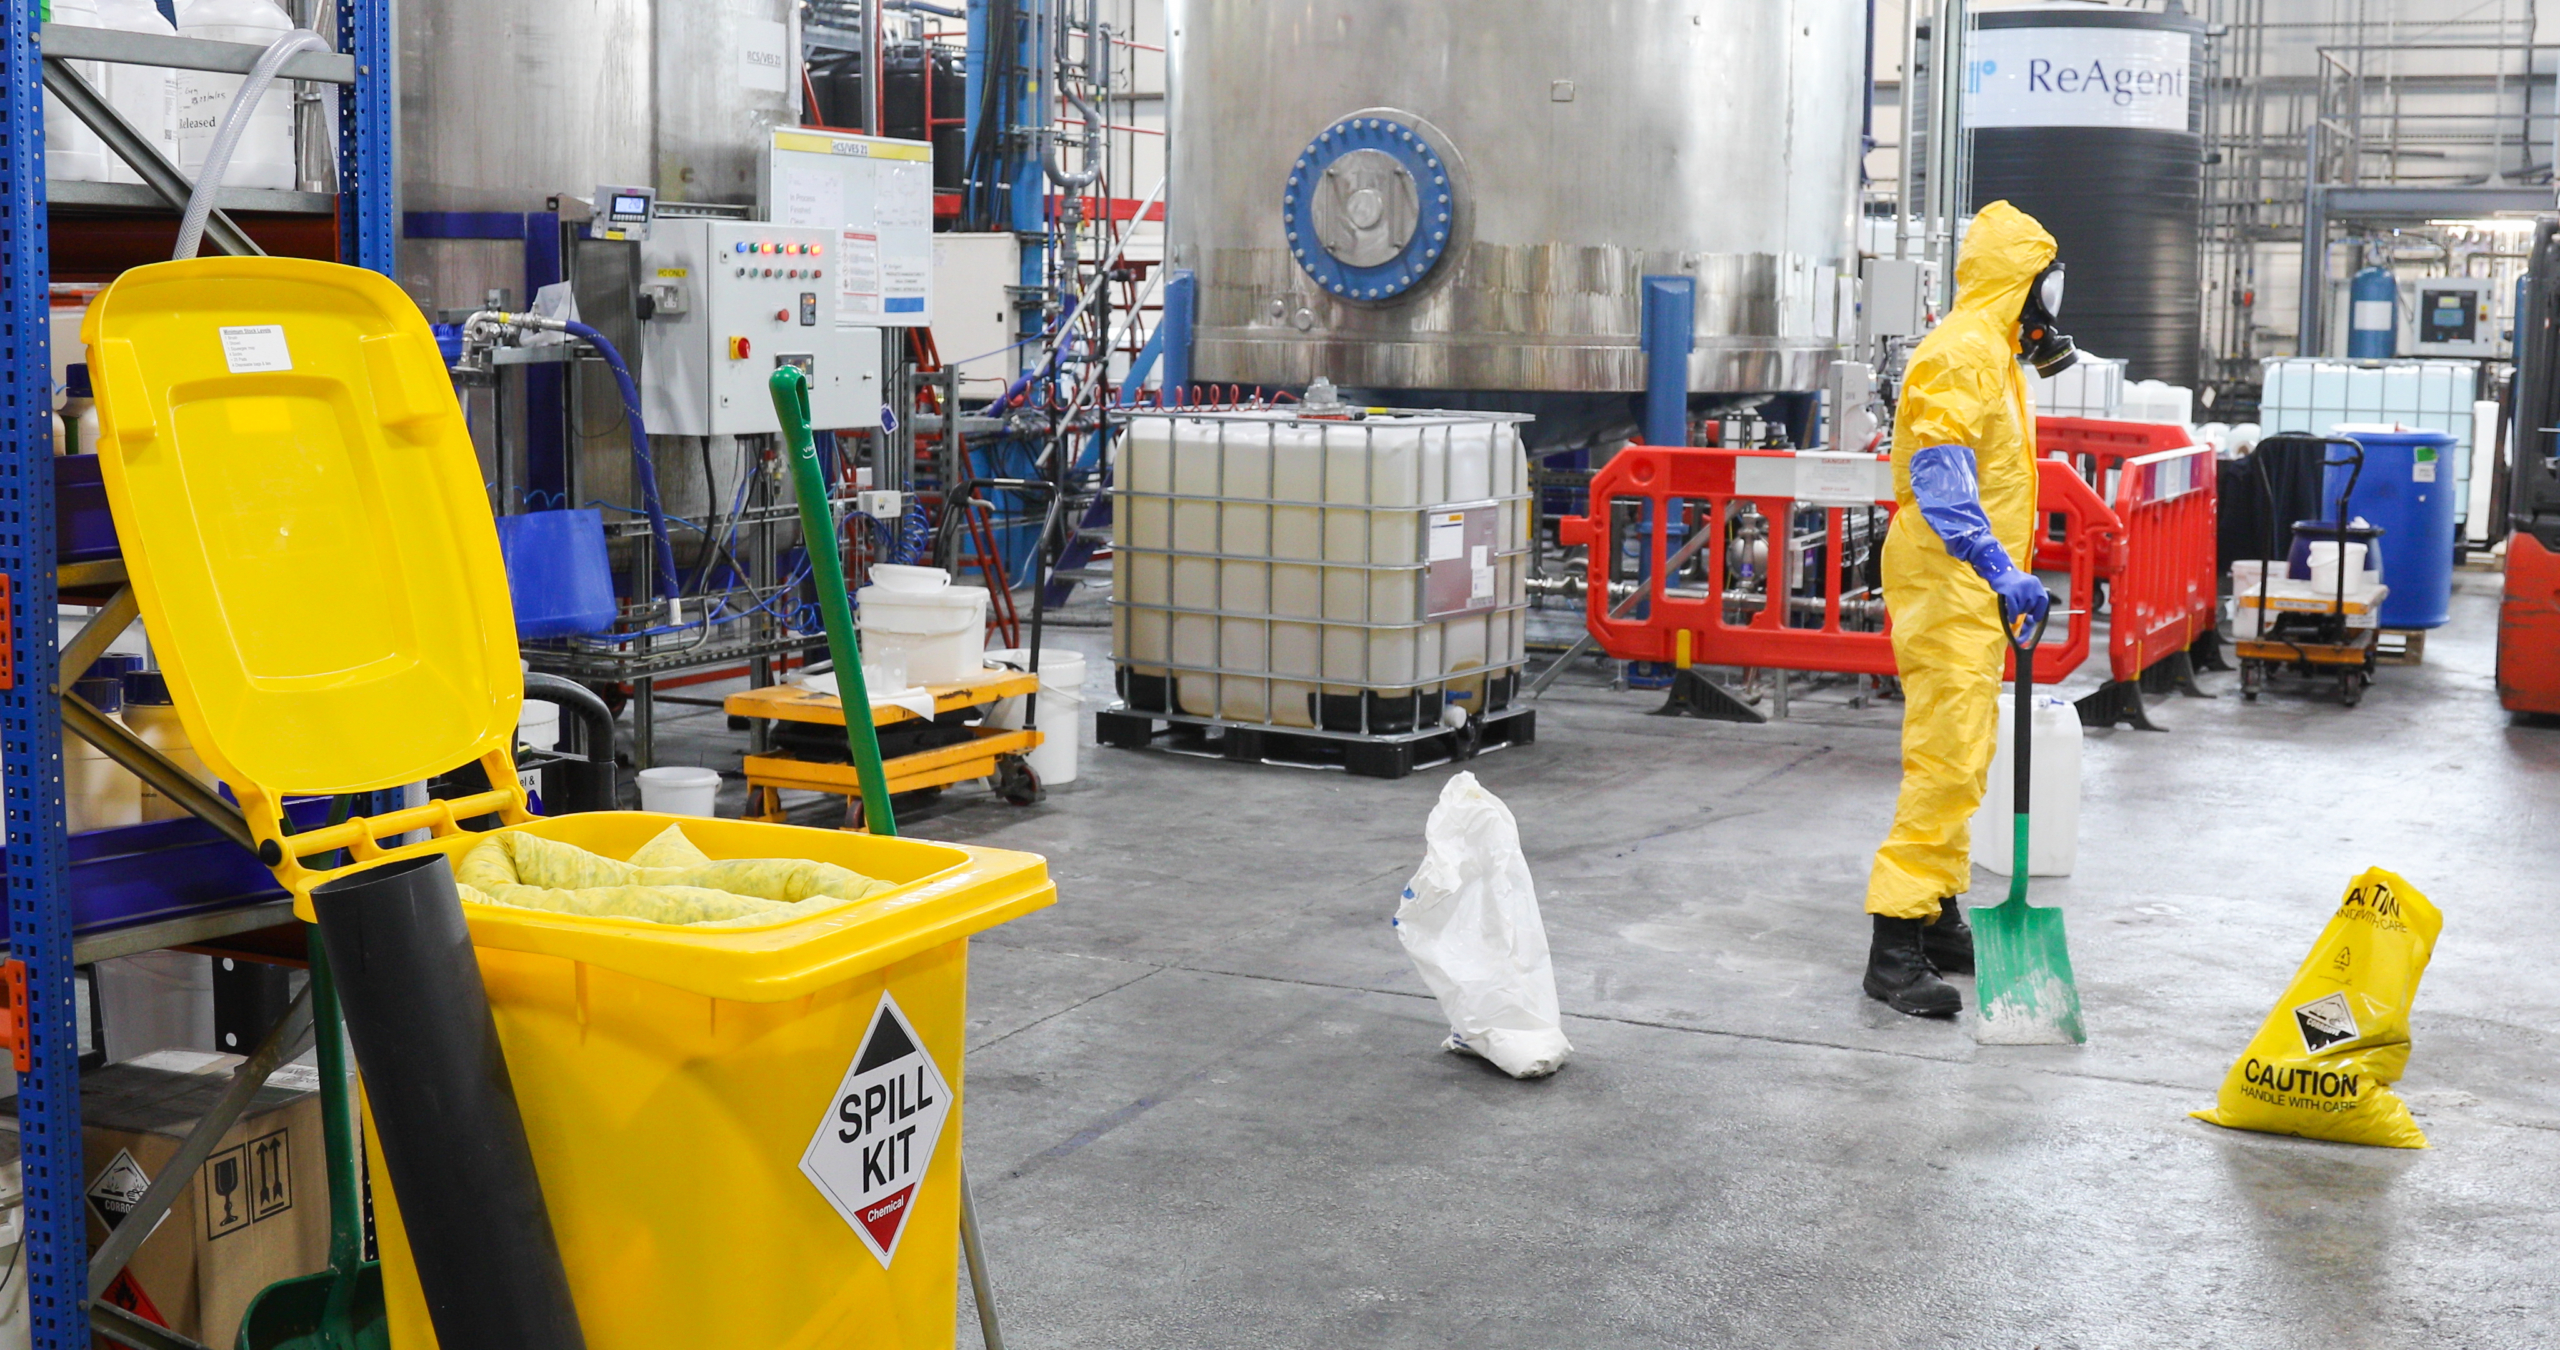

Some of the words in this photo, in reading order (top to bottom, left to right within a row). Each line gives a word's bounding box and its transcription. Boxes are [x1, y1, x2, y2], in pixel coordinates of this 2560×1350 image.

[747, 50, 774, 65] RCS/VES
[2029, 58, 2183, 107] ReAgent
[179, 116, 216, 129] Released
[832, 140, 860, 154] RCS/VES
[860, 144, 868, 155] 21
[668, 268, 687, 278] ONLY
[529, 775, 535, 786] &
[2245, 1058, 2359, 1098] CAUTION
[838, 1065, 933, 1144] SPILL
[2241, 1084, 2286, 1106] HANDLE
[2289, 1096, 2320, 1110] WITH
[2323, 1101, 2357, 1113] CARE
[863, 1124, 916, 1194] KIT
[105, 1200, 134, 1214] CORRO
[867, 1195, 905, 1223] Chemical
